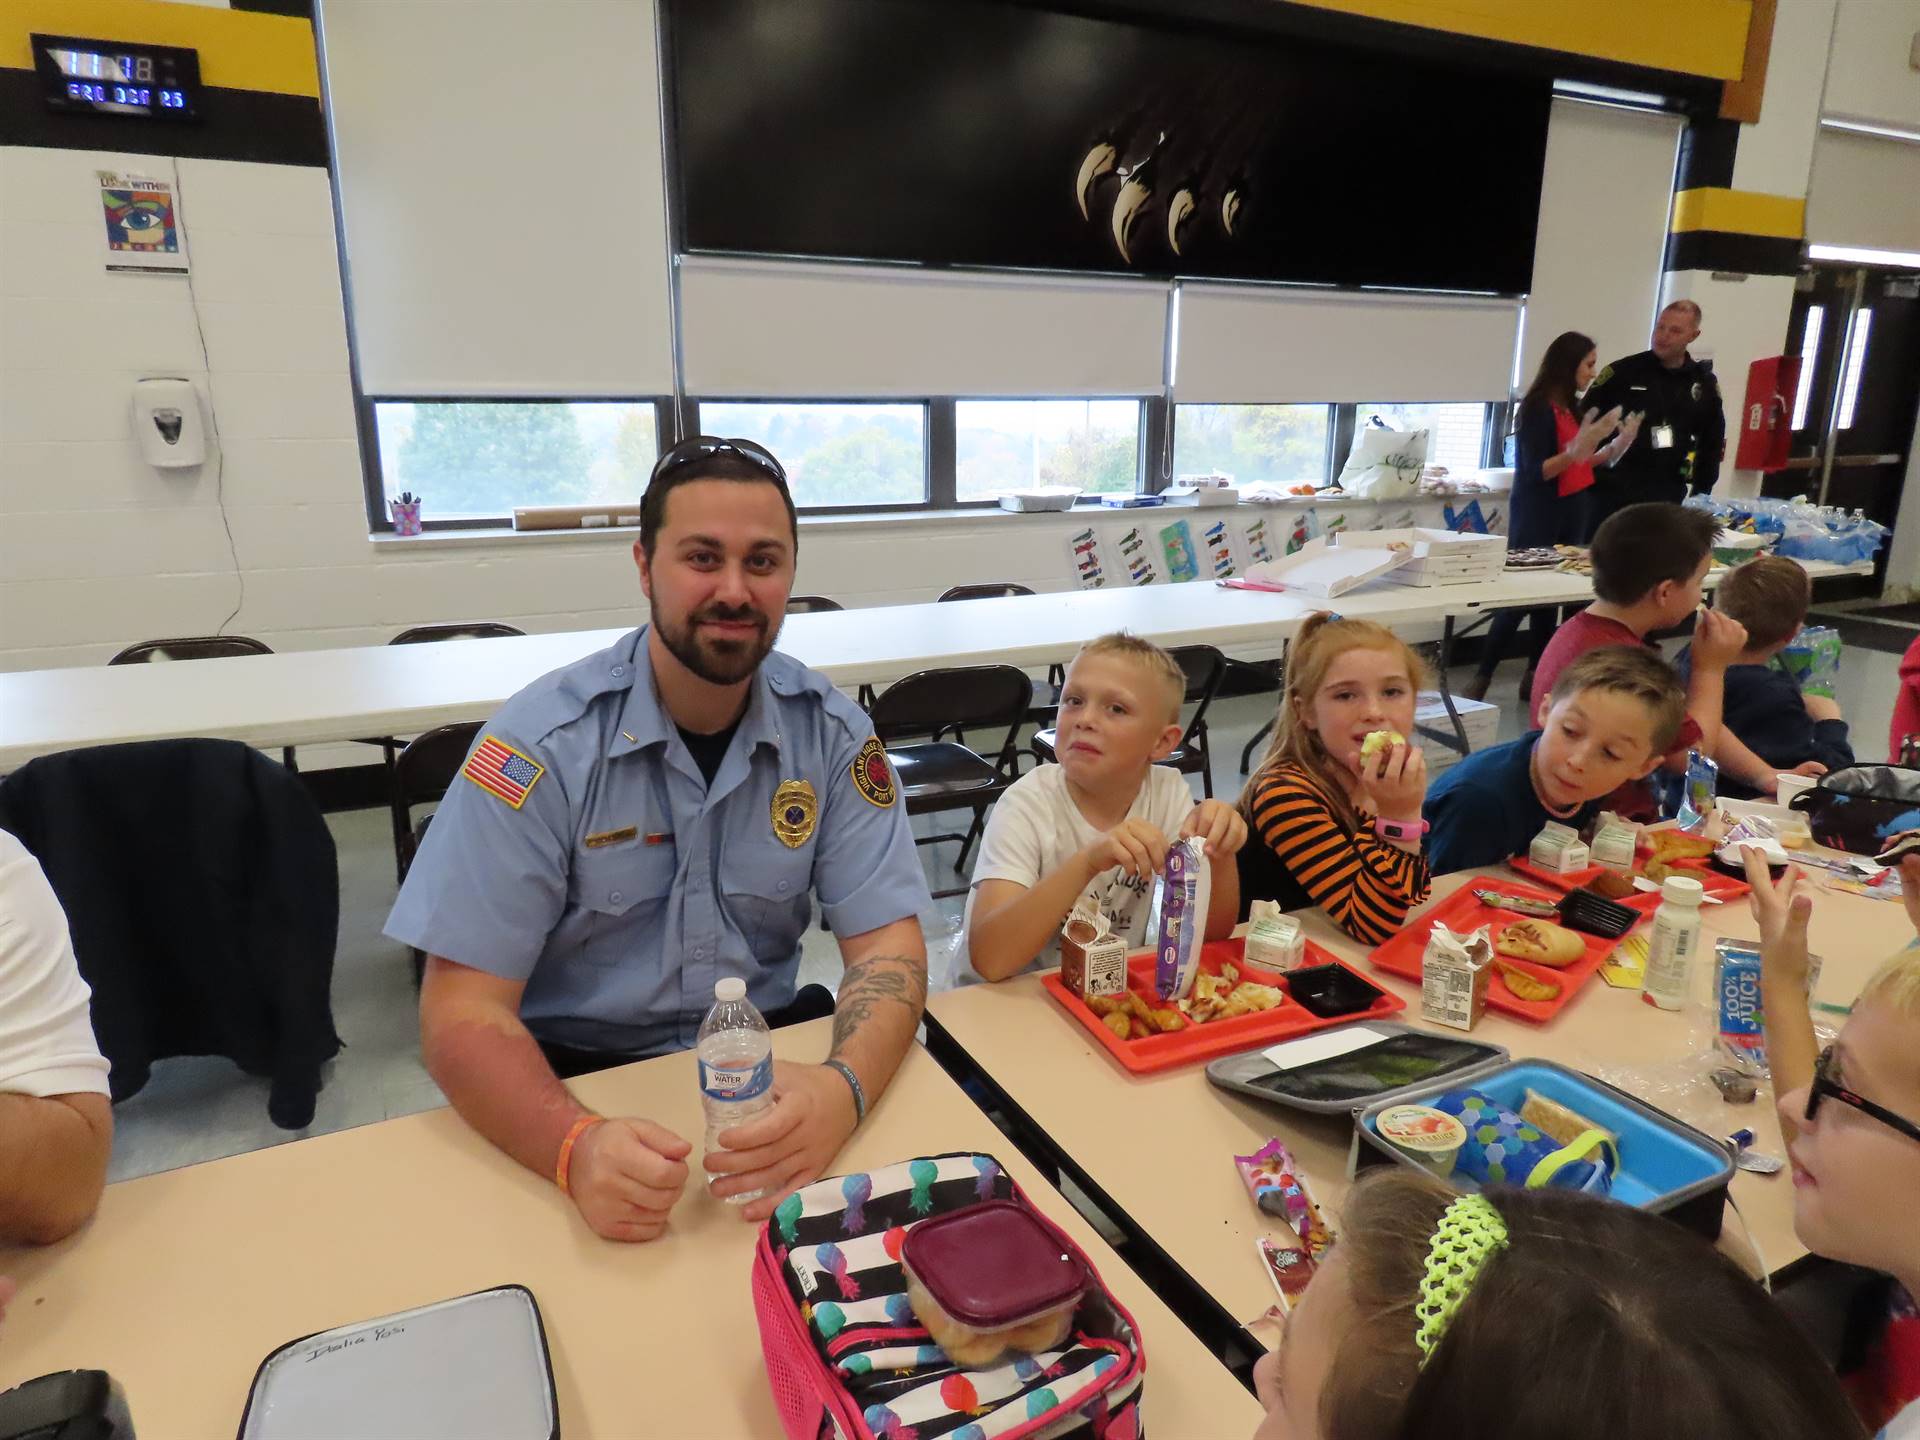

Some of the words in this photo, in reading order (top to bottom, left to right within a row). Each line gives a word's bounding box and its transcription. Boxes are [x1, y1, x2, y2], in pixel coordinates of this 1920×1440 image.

[862, 742, 877, 756] HOSE
[1725, 975, 1741, 1021] 100%
[1740, 971, 1758, 1031] JUICE
[714, 1075, 741, 1083] WATER
